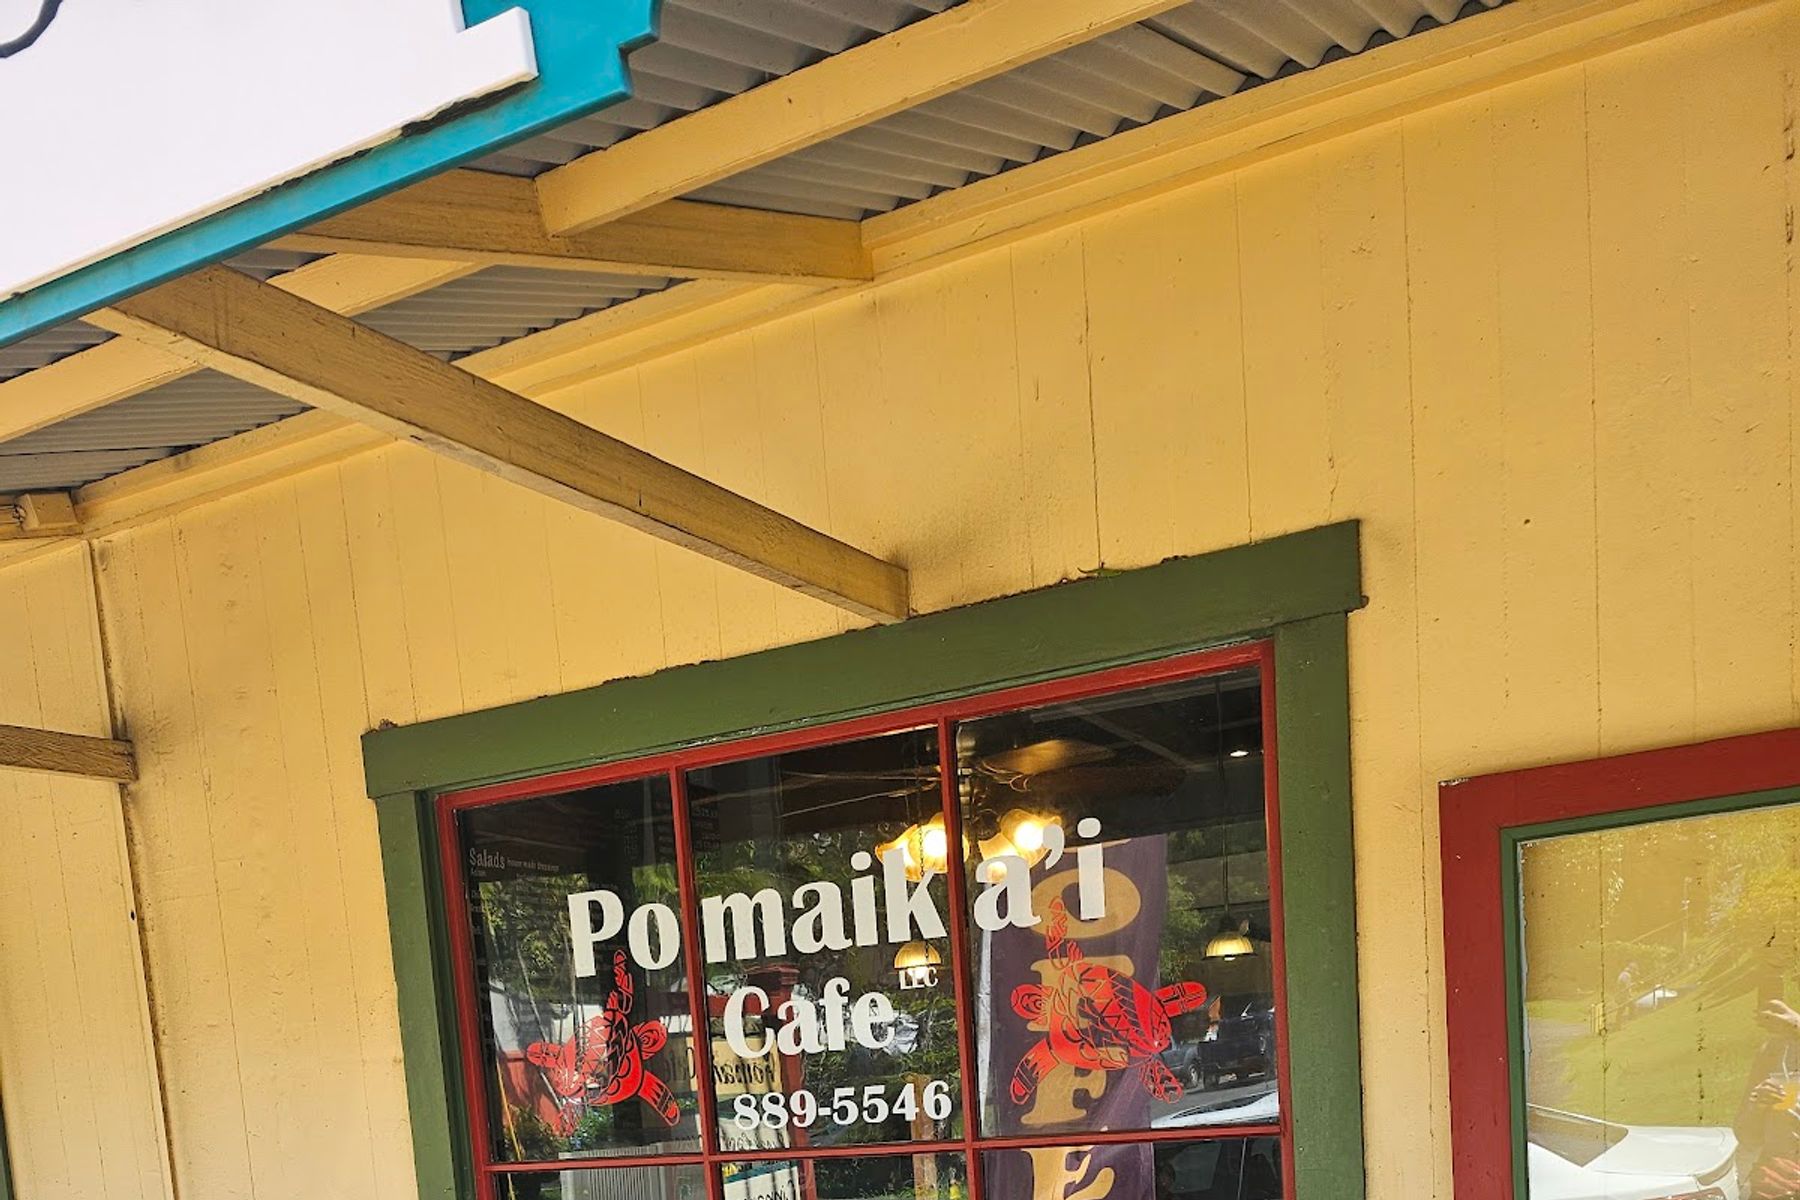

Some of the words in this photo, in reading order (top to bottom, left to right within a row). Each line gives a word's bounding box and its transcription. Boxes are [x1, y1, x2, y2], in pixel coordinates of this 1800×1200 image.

[469, 847, 505, 870] Salads
[722, 976, 895, 1059] Cafe
[732, 1080, 952, 1131] 889-5546
